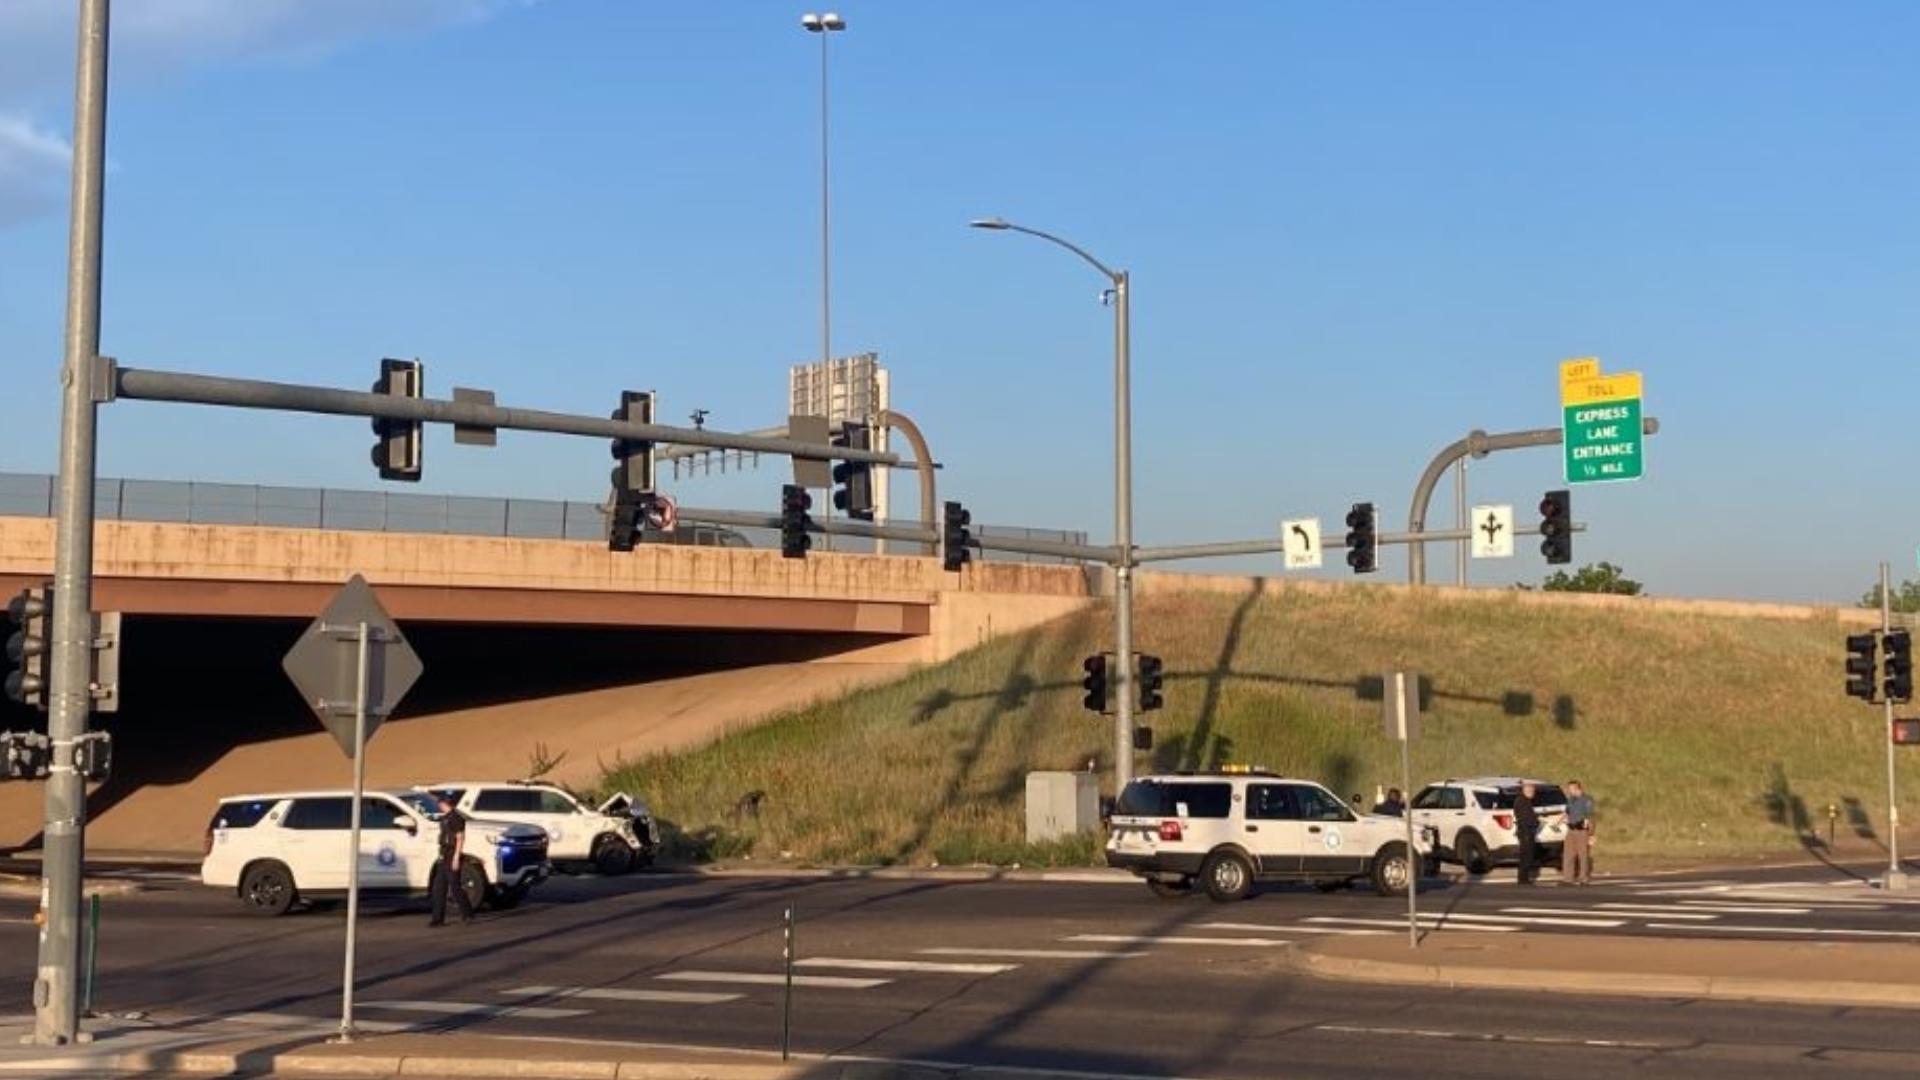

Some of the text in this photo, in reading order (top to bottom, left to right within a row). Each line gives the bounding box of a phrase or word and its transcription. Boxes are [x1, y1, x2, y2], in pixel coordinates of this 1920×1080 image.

[1576, 407, 1629, 424] EXPRESS
[1586, 425, 1618, 440] LANE
[1573, 442, 1634, 460] ENTRANCE
